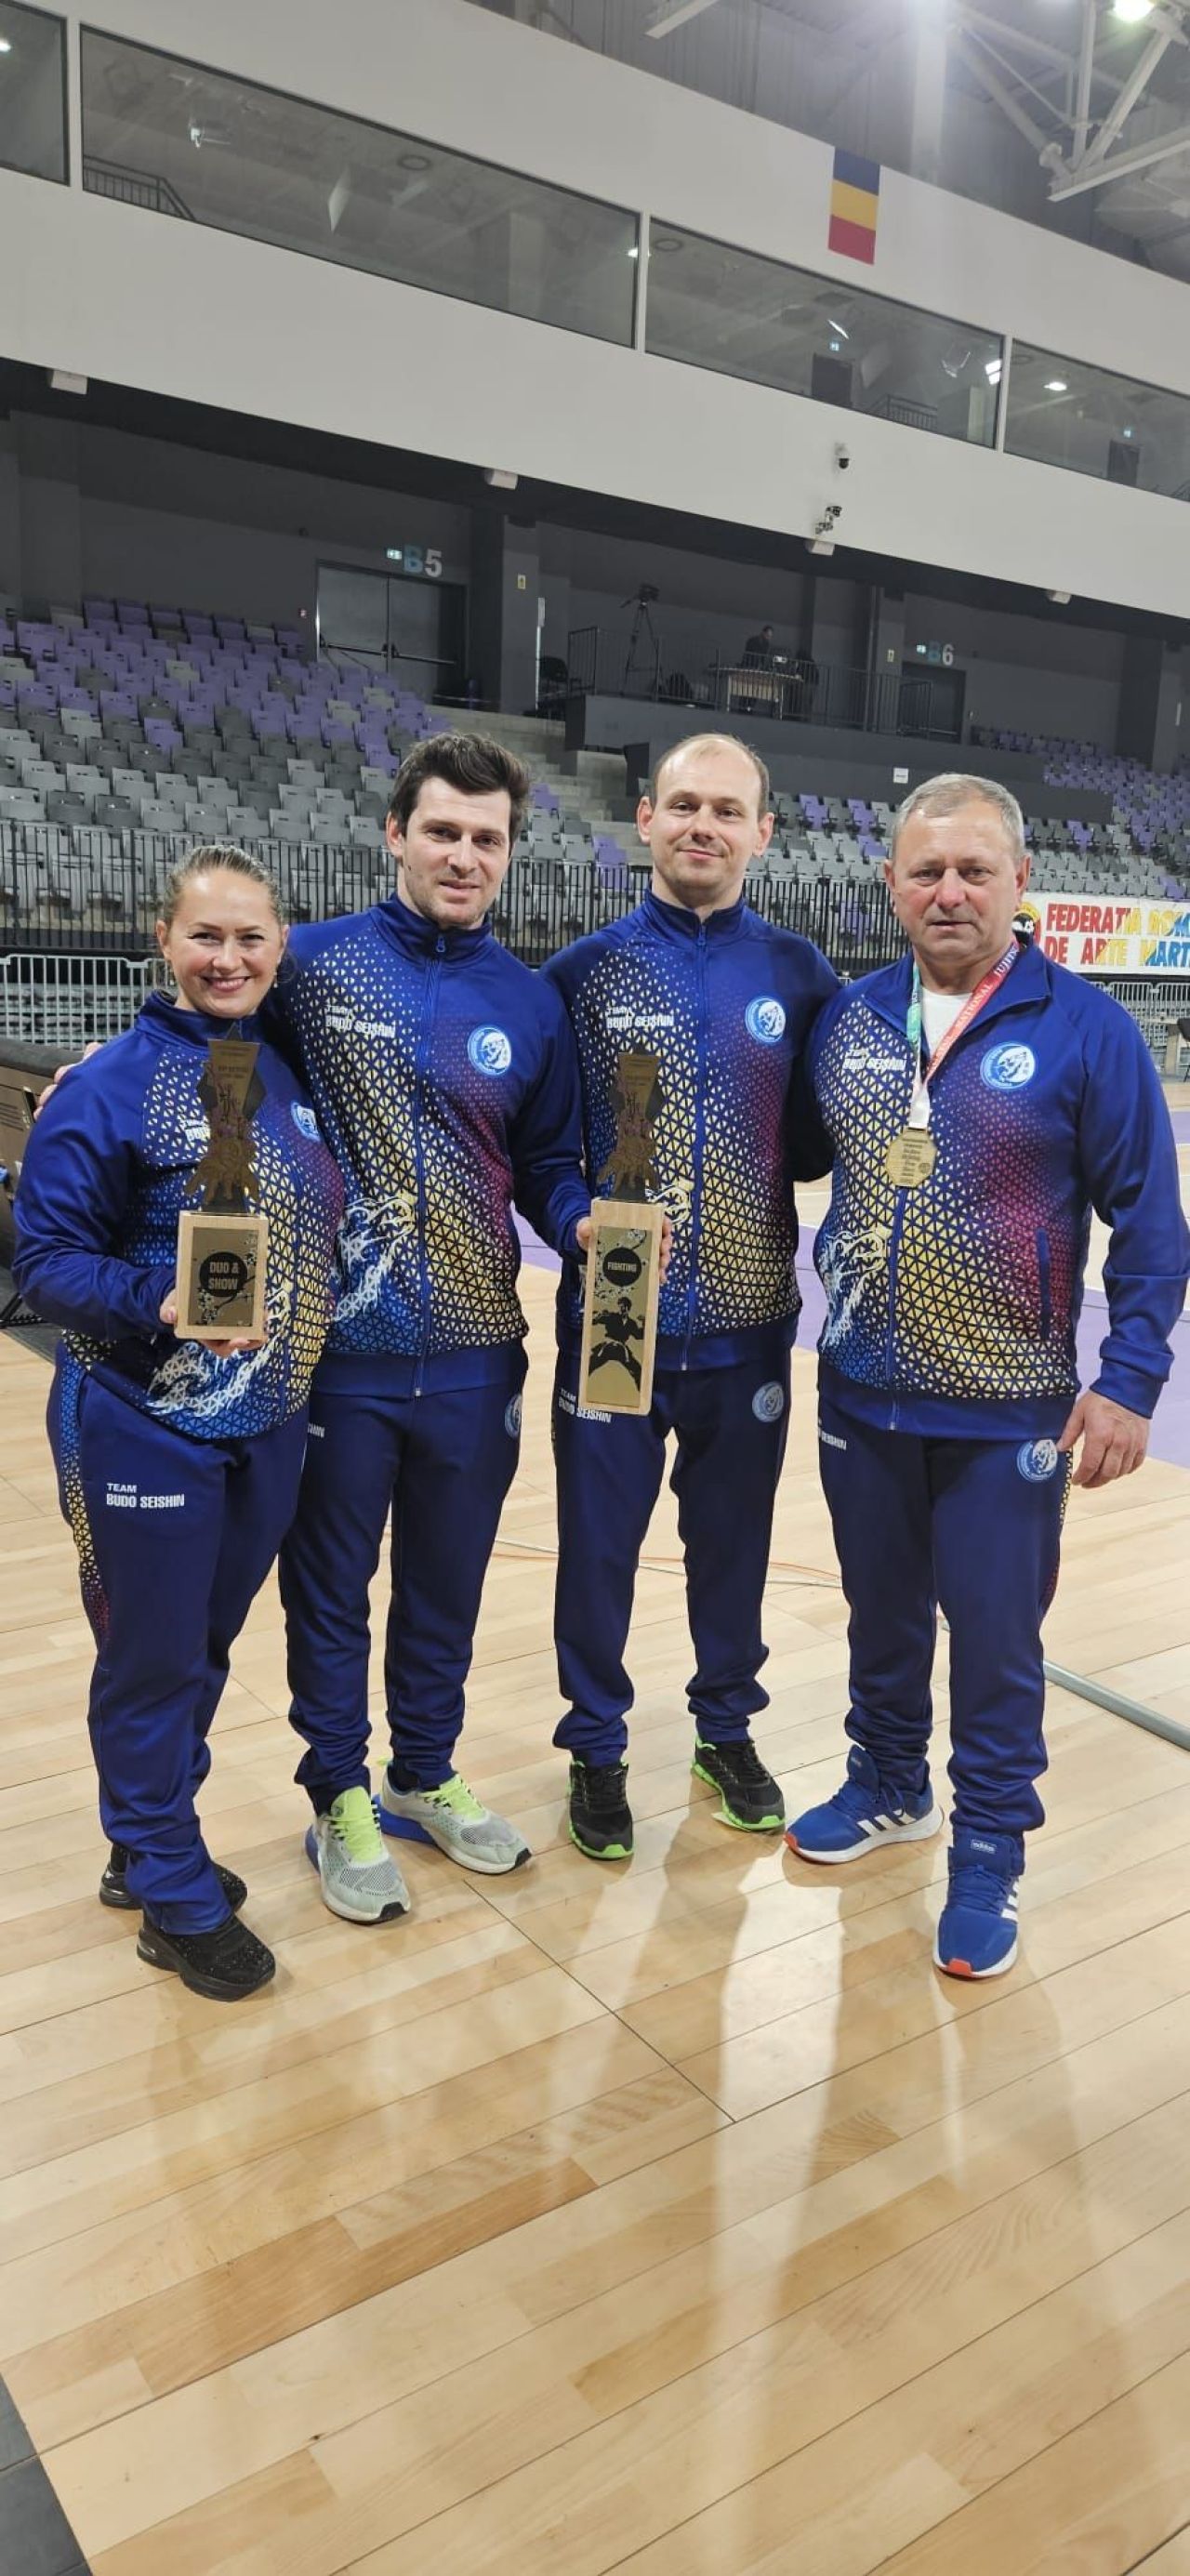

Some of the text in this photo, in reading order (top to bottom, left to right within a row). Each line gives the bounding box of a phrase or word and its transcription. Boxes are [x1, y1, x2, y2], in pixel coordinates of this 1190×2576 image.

[403, 546, 443, 578] B5
[1044, 935, 1069, 964] DE
[1080, 937, 1128, 966] ARTE
[209, 1262, 239, 1274] DUO &
[607, 1262, 637, 1273] FIGHTING
[208, 1278, 238, 1290] SHOW
[576, 1407, 612, 1423] SEISHIN
[107, 1482, 138, 1494] TEAM
[106, 1493, 185, 1508] BUDO SEISHIN
